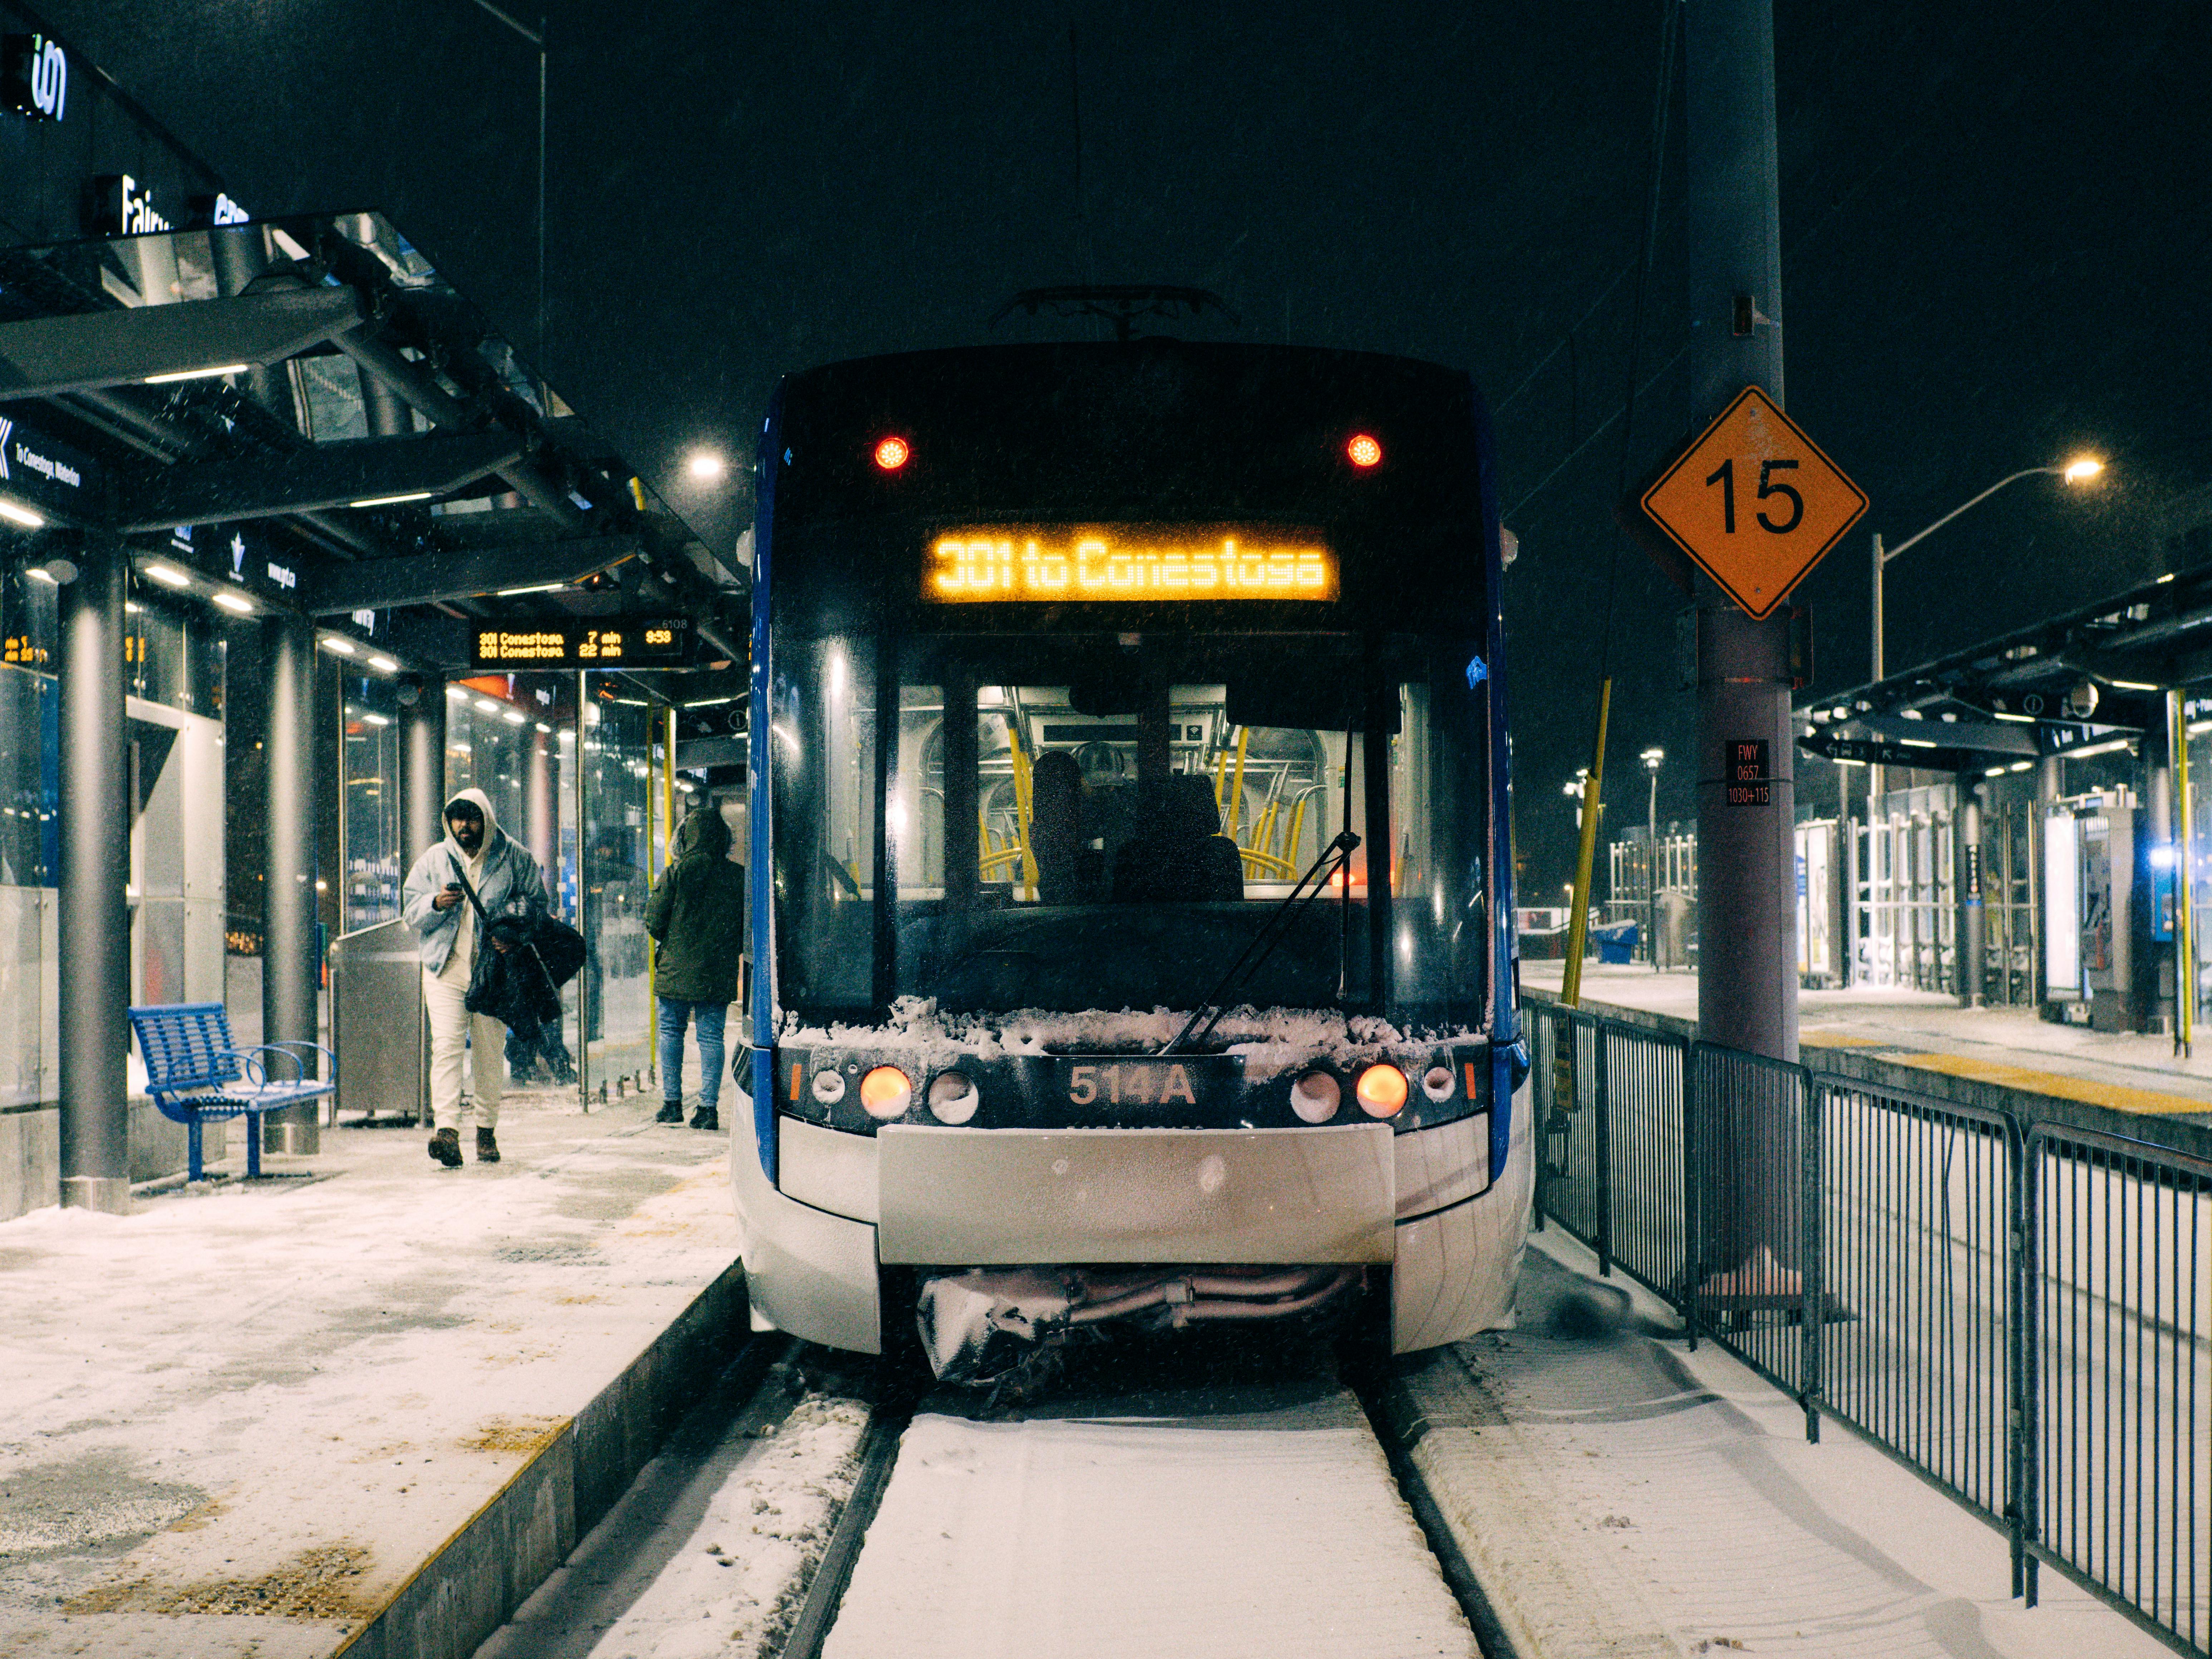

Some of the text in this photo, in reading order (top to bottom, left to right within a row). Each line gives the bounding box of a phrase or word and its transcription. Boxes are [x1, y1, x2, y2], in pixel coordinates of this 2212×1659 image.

[16, 442, 23, 463] To
[1706, 459, 1803, 534] 15
[937, 541, 1011, 588] 301
[1022, 541, 1068, 588] to
[662, 619, 688, 629] 6108
[480, 632, 564, 645] 301 Conestoga
[588, 630, 621, 644] 7 min
[645, 630, 672, 644] 9:53
[480, 645, 564, 658] 301 Conestoga
[579, 644, 621, 657] 22 min
[1739, 744, 1758, 760] FWY
[1737, 765, 1759, 780] 0657
[1729, 787, 1769, 803] 1030+115
[1070, 1064, 1196, 1104] 514A
